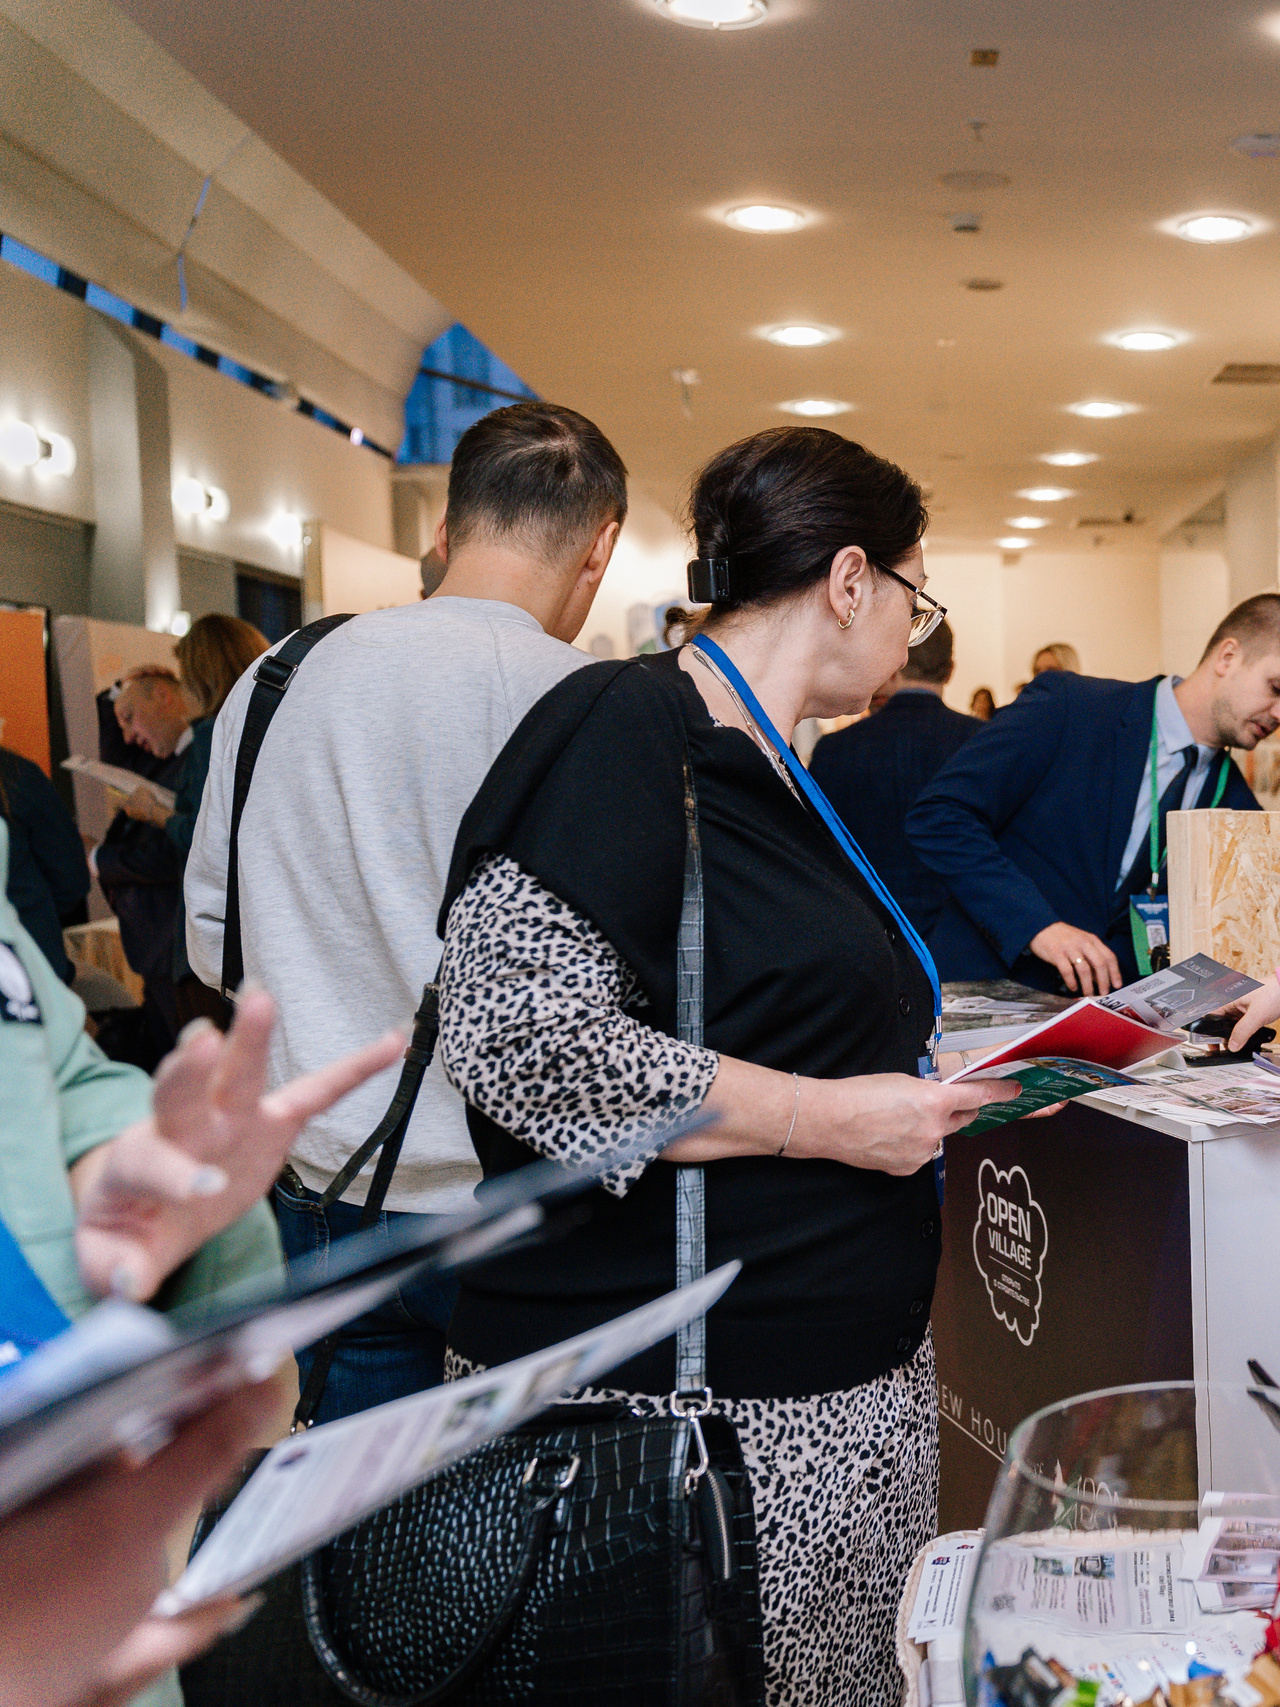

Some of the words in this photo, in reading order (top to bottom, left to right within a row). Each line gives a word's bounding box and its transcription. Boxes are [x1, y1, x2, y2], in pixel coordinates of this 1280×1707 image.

[987, 1191, 1031, 1243] OPEN
[988, 1227, 1032, 1271] VILLAGE
[937, 1380, 963, 1420] EW
